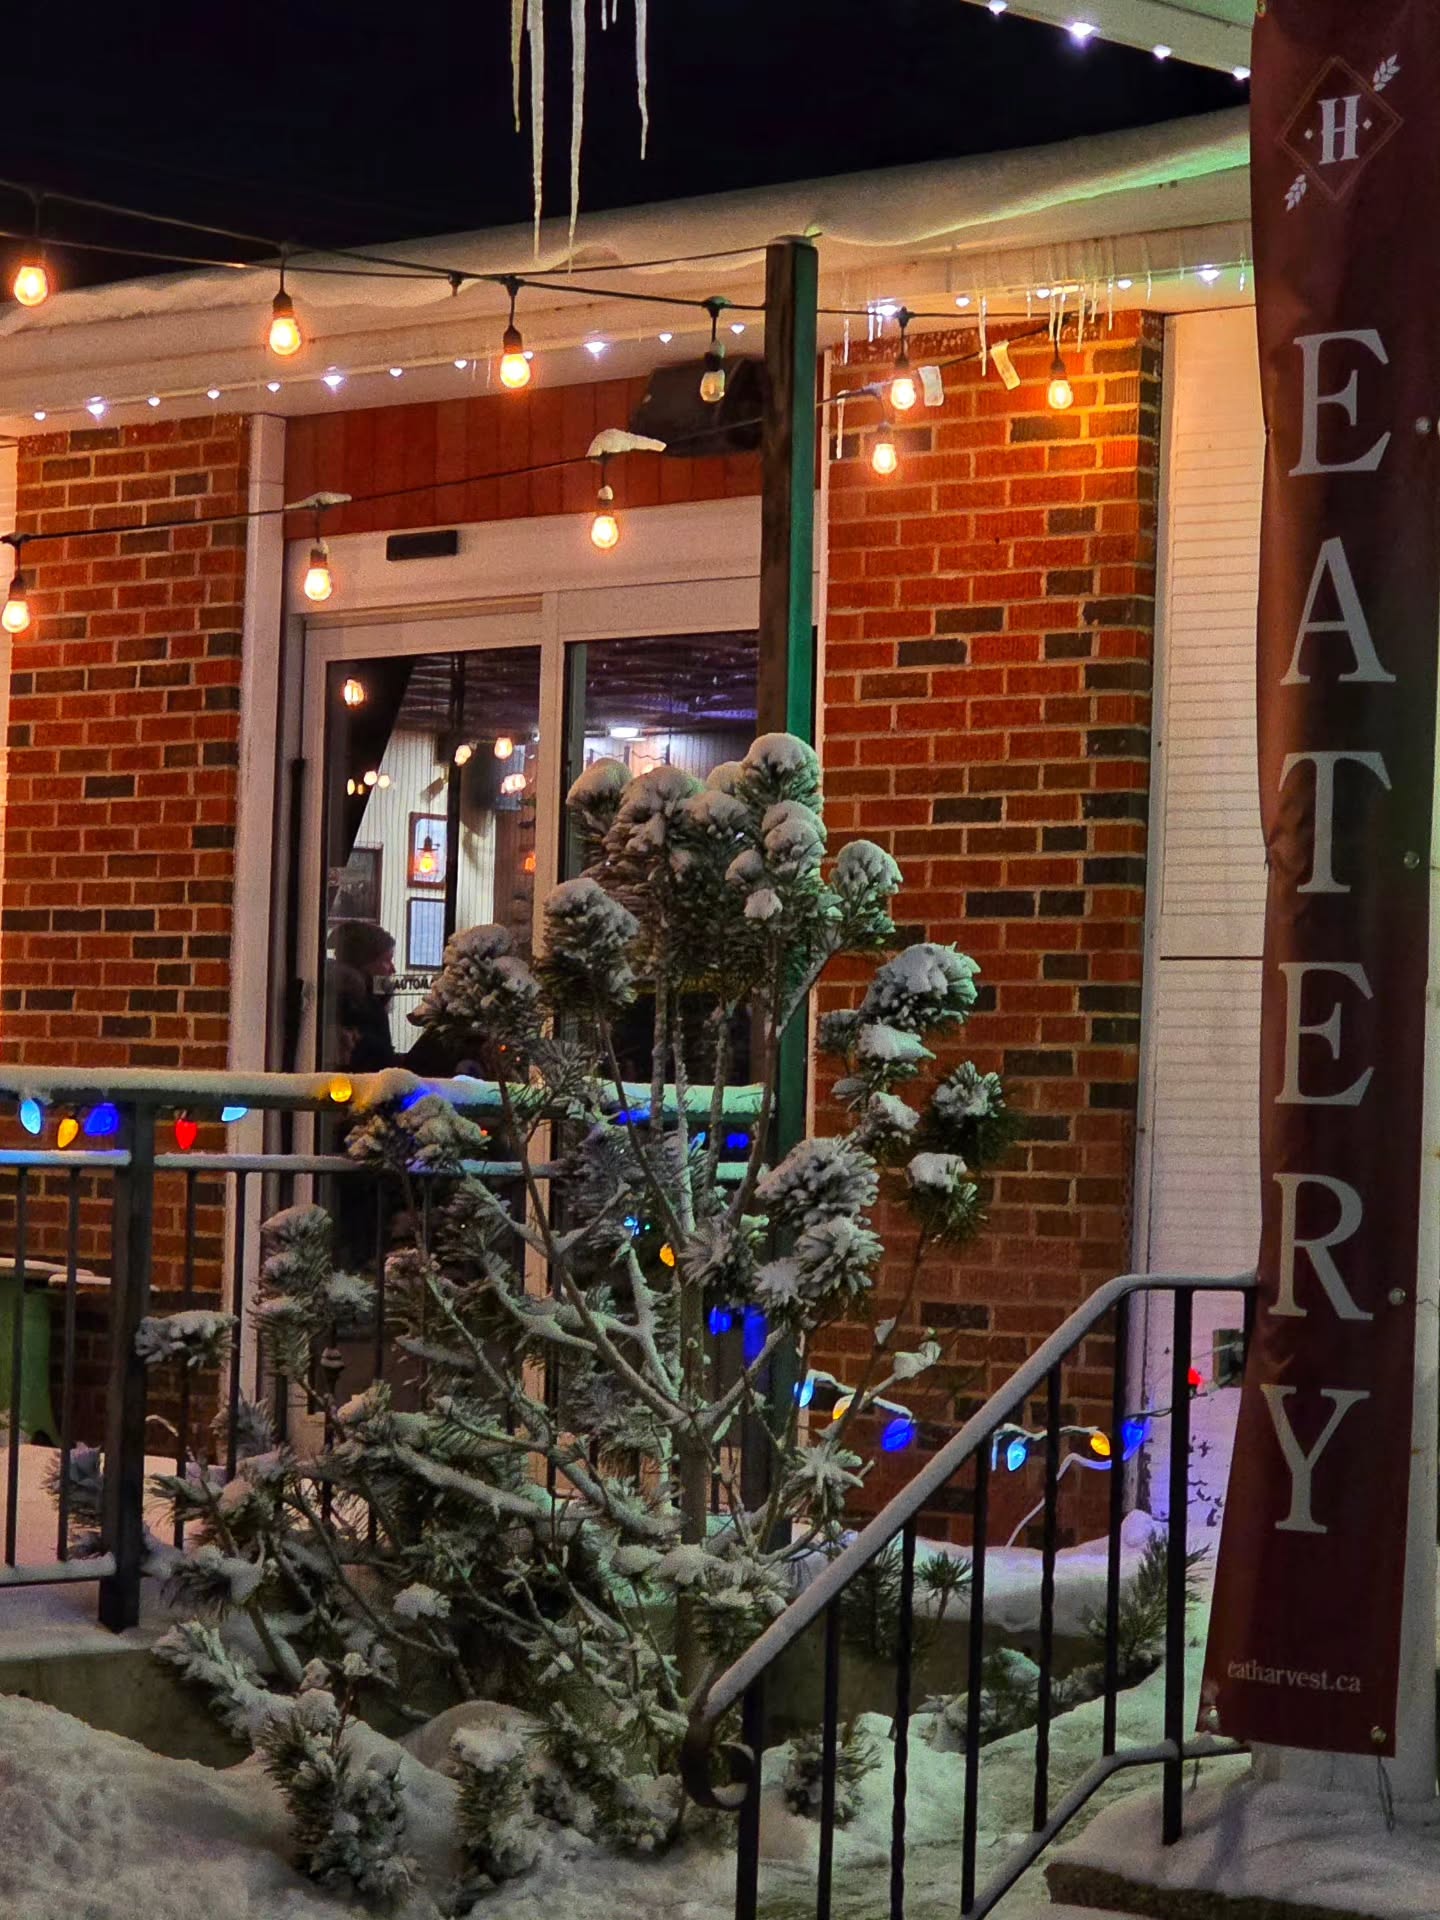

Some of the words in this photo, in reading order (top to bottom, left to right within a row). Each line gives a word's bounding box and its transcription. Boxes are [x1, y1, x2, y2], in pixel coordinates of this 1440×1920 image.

[1318, 94, 1361, 165] H
[1260, 329, 1396, 1533] EATERY
[1227, 1659, 1361, 1693] eatharvest.ca
